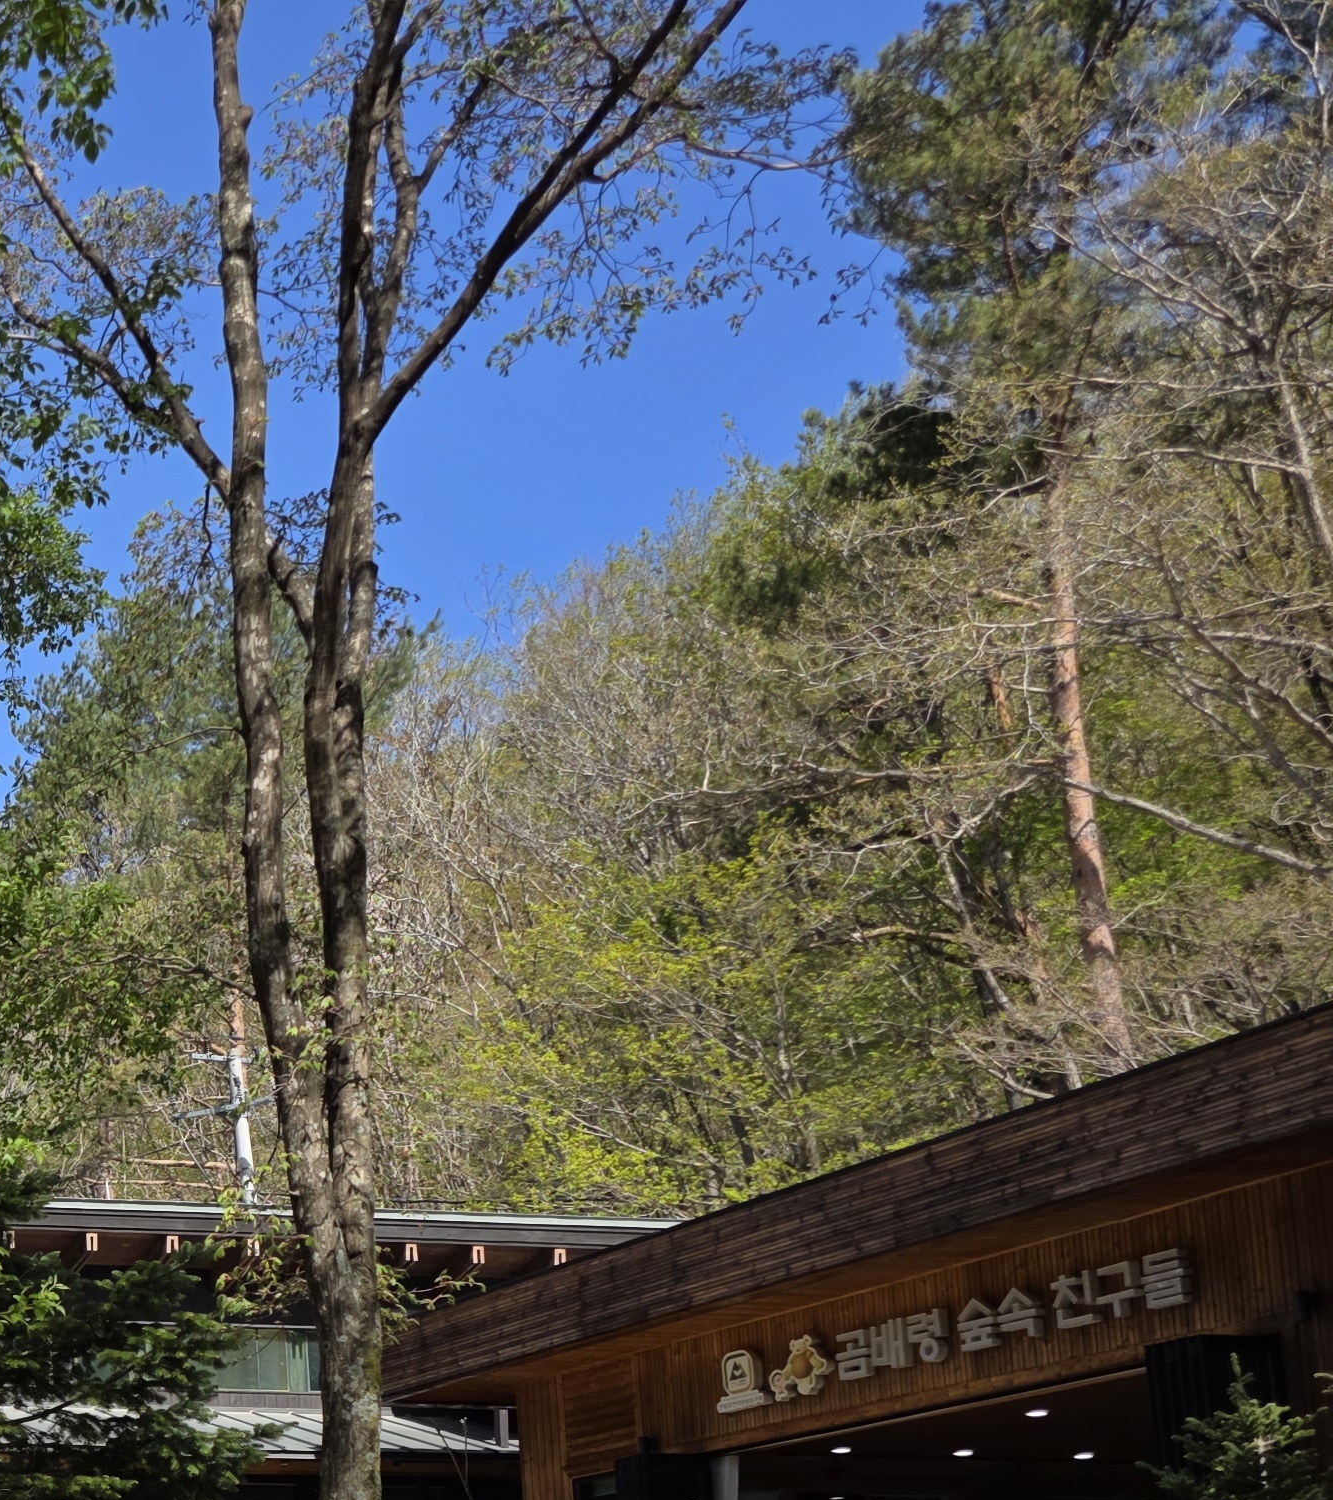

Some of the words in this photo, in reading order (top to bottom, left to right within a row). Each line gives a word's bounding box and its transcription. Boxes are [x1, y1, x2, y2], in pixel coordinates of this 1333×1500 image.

[835, 1308, 950, 1381] 곰배령
[957, 1287, 1046, 1353] 숲속
[1050, 1248, 1194, 1330] 친구들
